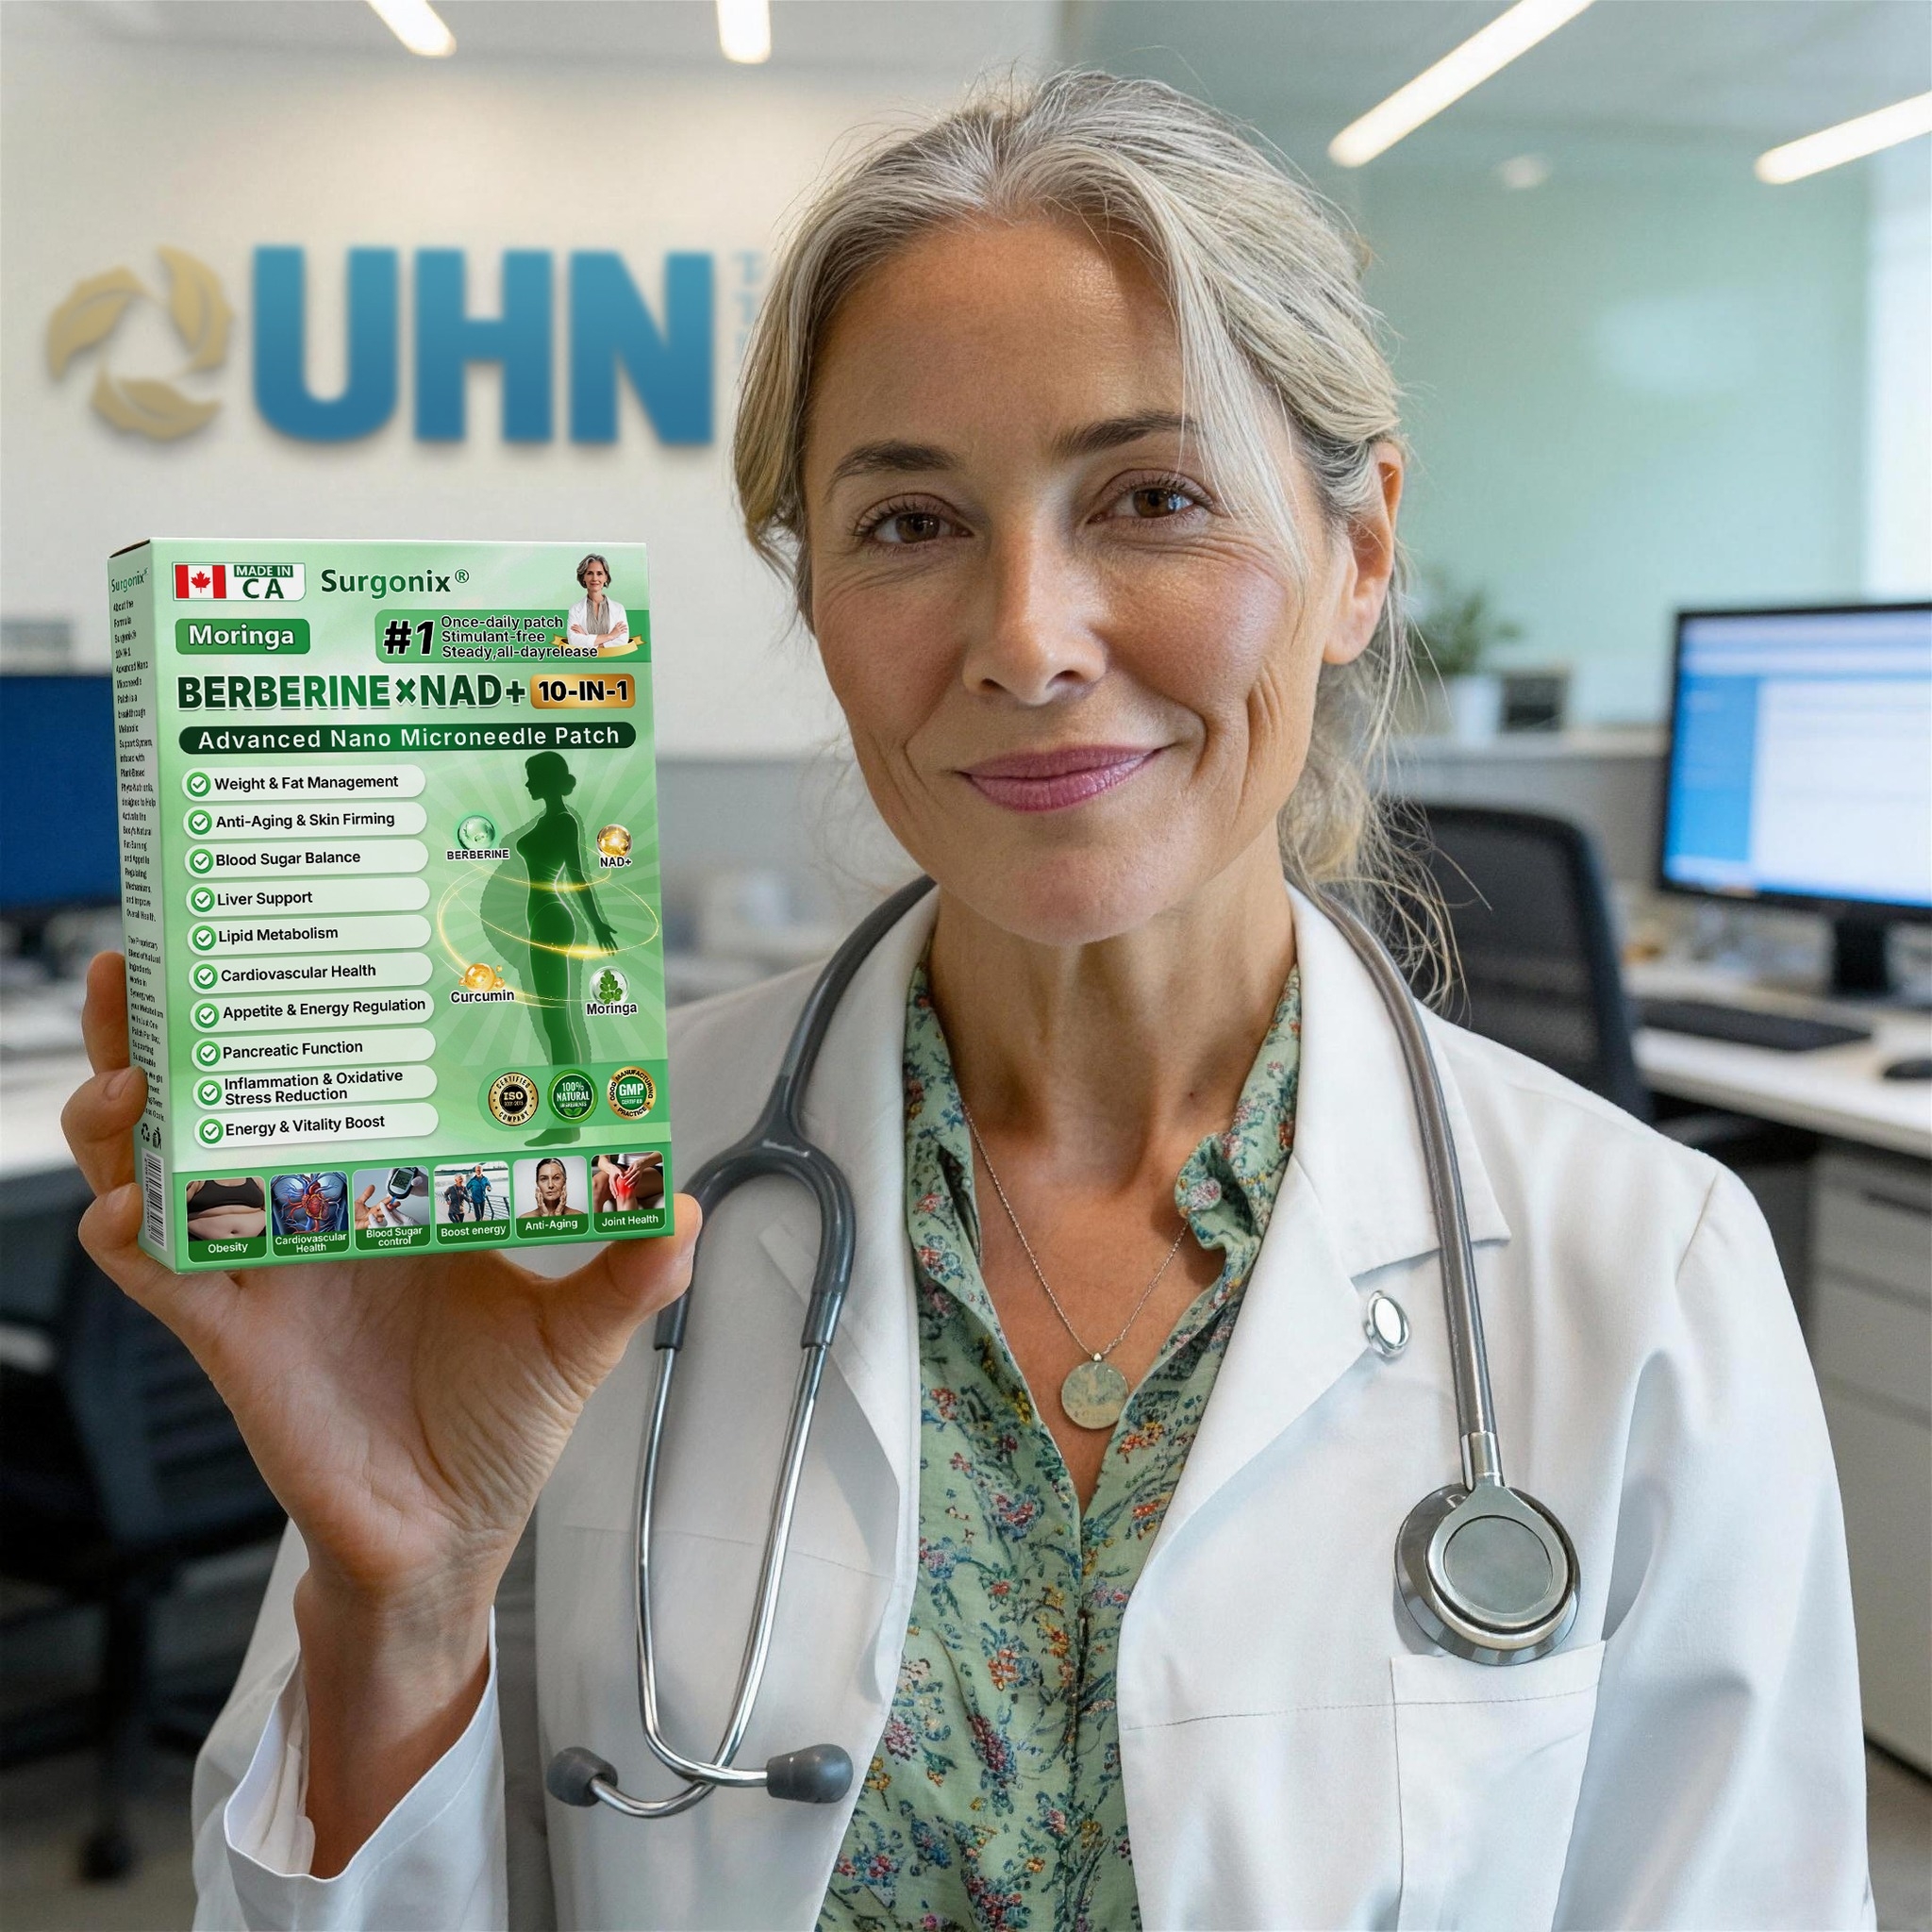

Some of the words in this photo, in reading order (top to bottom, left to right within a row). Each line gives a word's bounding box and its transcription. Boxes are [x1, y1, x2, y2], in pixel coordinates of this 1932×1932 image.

[253, 245, 715, 446] UHN
[236, 566, 273, 576] MADE
[277, 565, 291, 576] IN
[441, 615, 519, 631] Once-daily
[524, 615, 563, 631] patch
[189, 624, 294, 650] Moringa
[382, 619, 434, 655] #1
[441, 630, 545, 644] Stimulant-free
[538, 680, 628, 702] 10-IN-1
[198, 729, 321, 750] Advanced
[330, 729, 391, 748] Nano
[401, 727, 546, 747] Microneedle
[556, 726, 619, 744] Patch
[214, 776, 265, 792] Weight
[269, 776, 279, 790] &
[282, 776, 304, 790] Fat
[308, 775, 399, 791] Management
[216, 815, 292, 830] Anti-Aging
[296, 814, 307, 826] &
[309, 813, 340, 826] Skin
[342, 812, 395, 826] Firming
[216, 854, 257, 866] Blood
[260, 853, 301, 868] Sugar
[306, 852, 361, 865] Balance
[446, 849, 509, 860] BERBERINE
[600, 858, 632, 868] NAD+
[217, 893, 253, 906] Liver
[257, 891, 313, 908] Support
[219, 929, 253, 945] Lipid
[257, 927, 339, 941] Metabolism
[221, 968, 327, 982] Cardiovascular
[331, 964, 376, 978] Health
[451, 990, 515, 1004] Curcumin
[223, 1005, 283, 1021] Appetite
[287, 1004, 297, 1016] &
[300, 1001, 349, 1016] Energy
[353, 998, 425, 1015] Regulation
[586, 1003, 638, 1016] Moringa
[223, 1043, 298, 1059] Pancreatic
[302, 1041, 363, 1056] Function
[225, 1074, 319, 1091] Inflammation
[323, 1074, 333, 1085] &
[336, 1070, 403, 1084] Oxidative
[495, 1075, 531, 1090] CERTIFIED
[562, 1081, 584, 1092] 100%
[503, 1091, 524, 1101] ISO
[556, 1091, 591, 1102] NATURAL
[619, 1083, 644, 1096] GMP
[225, 1092, 272, 1106] Stress
[275, 1088, 348, 1103] Reduction
[617, 1106, 647, 1117] PRACTICE
[225, 1123, 276, 1137] Energy
[279, 1121, 290, 1133] &
[292, 1117, 341, 1133] Vitality
[345, 1115, 385, 1129] Boost
[525, 1219, 578, 1231] Anti-Aging
[602, 1215, 625, 1226] Joint
[627, 1214, 658, 1225] Health
[366, 1228, 391, 1239] Blood
[394, 1226, 423, 1240] Sugar
[441, 1227, 470, 1237] Boost
[472, 1224, 507, 1237] energy
[275, 1232, 347, 1245] Cardiovascular
[378, 1236, 411, 1246] control
[208, 1241, 248, 1254] Obesity
[296, 1242, 326, 1254] Health
